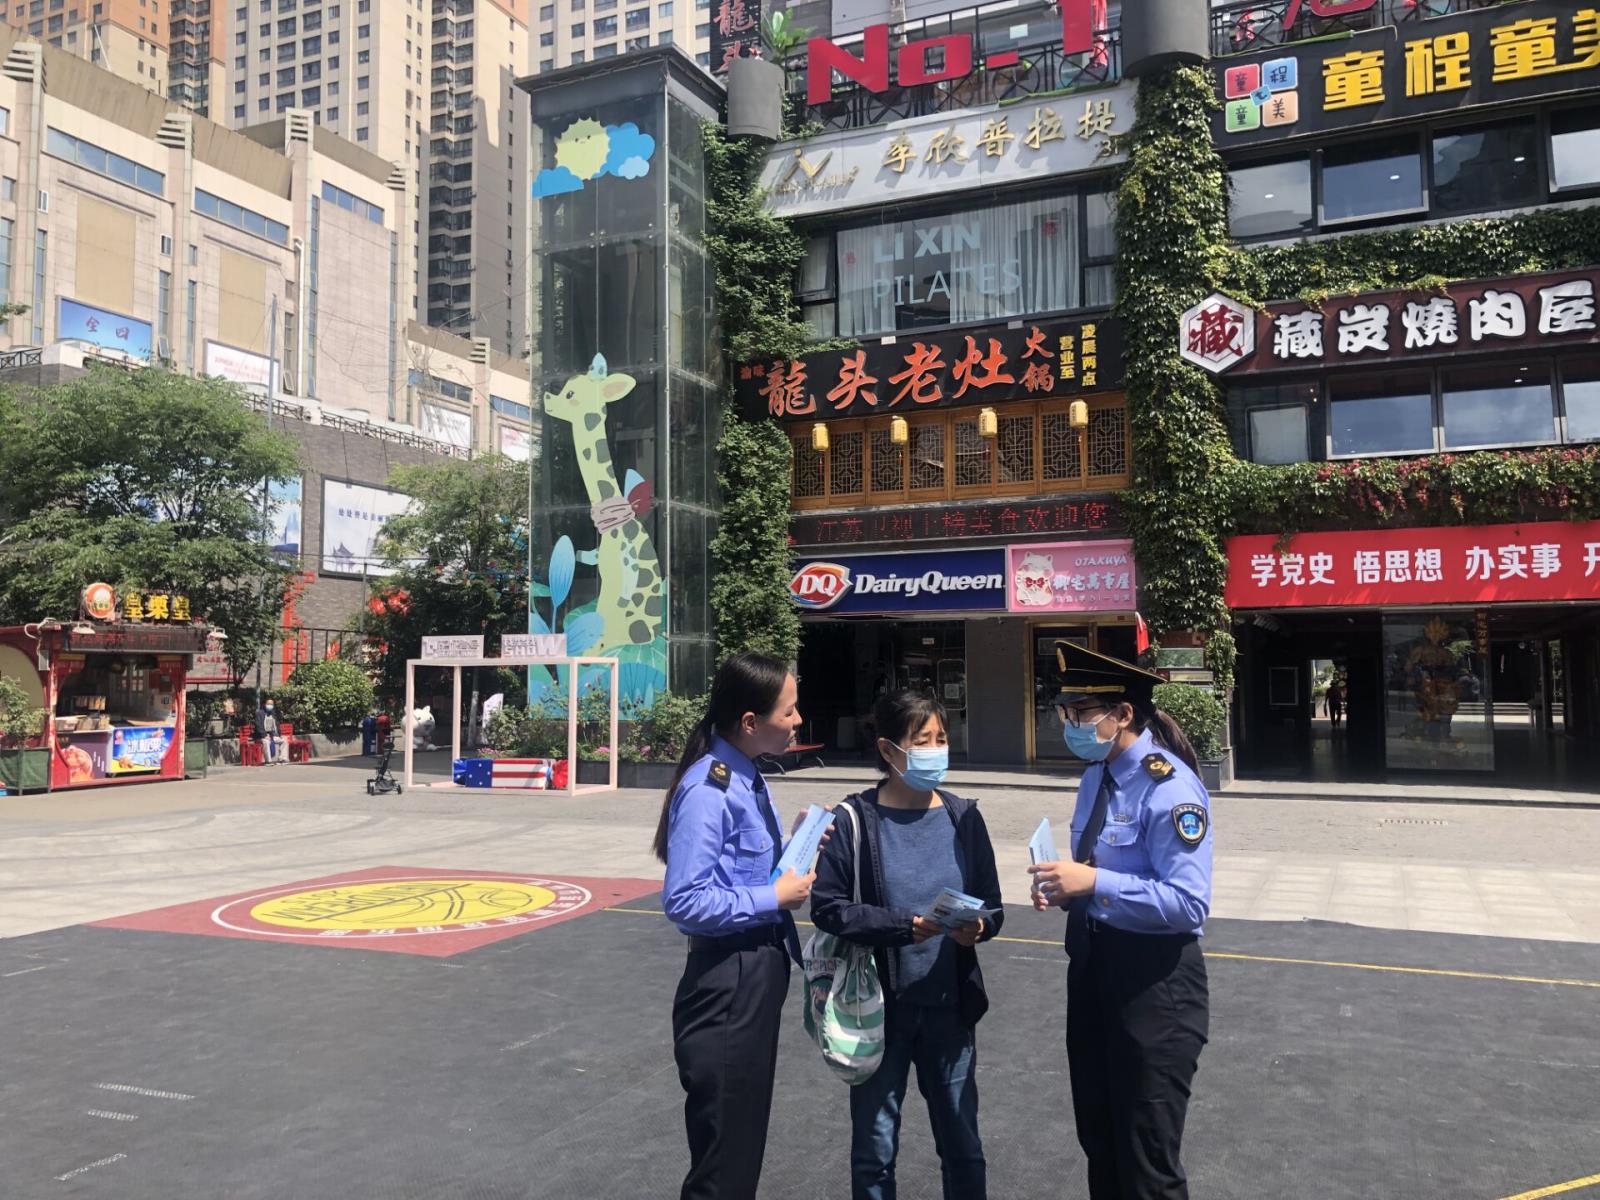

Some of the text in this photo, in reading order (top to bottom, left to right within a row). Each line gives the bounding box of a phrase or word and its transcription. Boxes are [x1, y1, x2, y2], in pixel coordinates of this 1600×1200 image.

[873, 257, 1022, 309] PILATES
[799, 573, 838, 597] DQ
[1250, 551, 1336, 588] 学党史
[1353, 548, 1444, 584] 悟思想
[1465, 543, 1562, 580] 办实事
